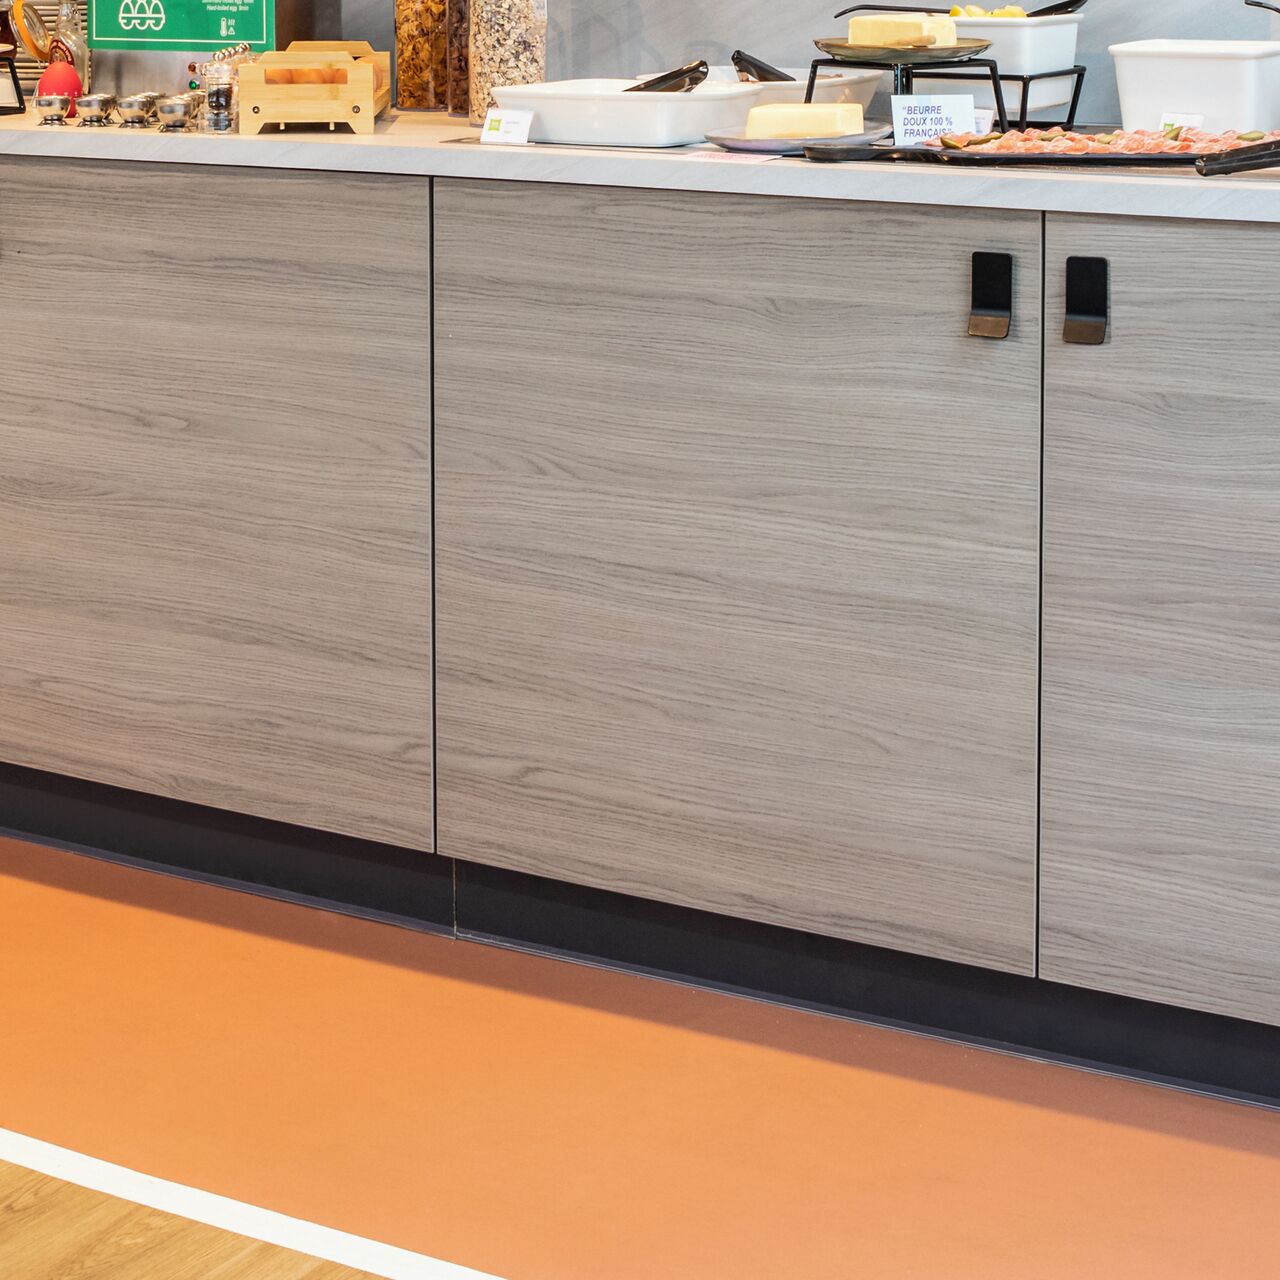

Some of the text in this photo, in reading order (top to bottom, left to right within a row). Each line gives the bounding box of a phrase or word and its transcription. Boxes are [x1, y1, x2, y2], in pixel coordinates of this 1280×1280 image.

[903, 116, 953, 126] DOUX 100 %
